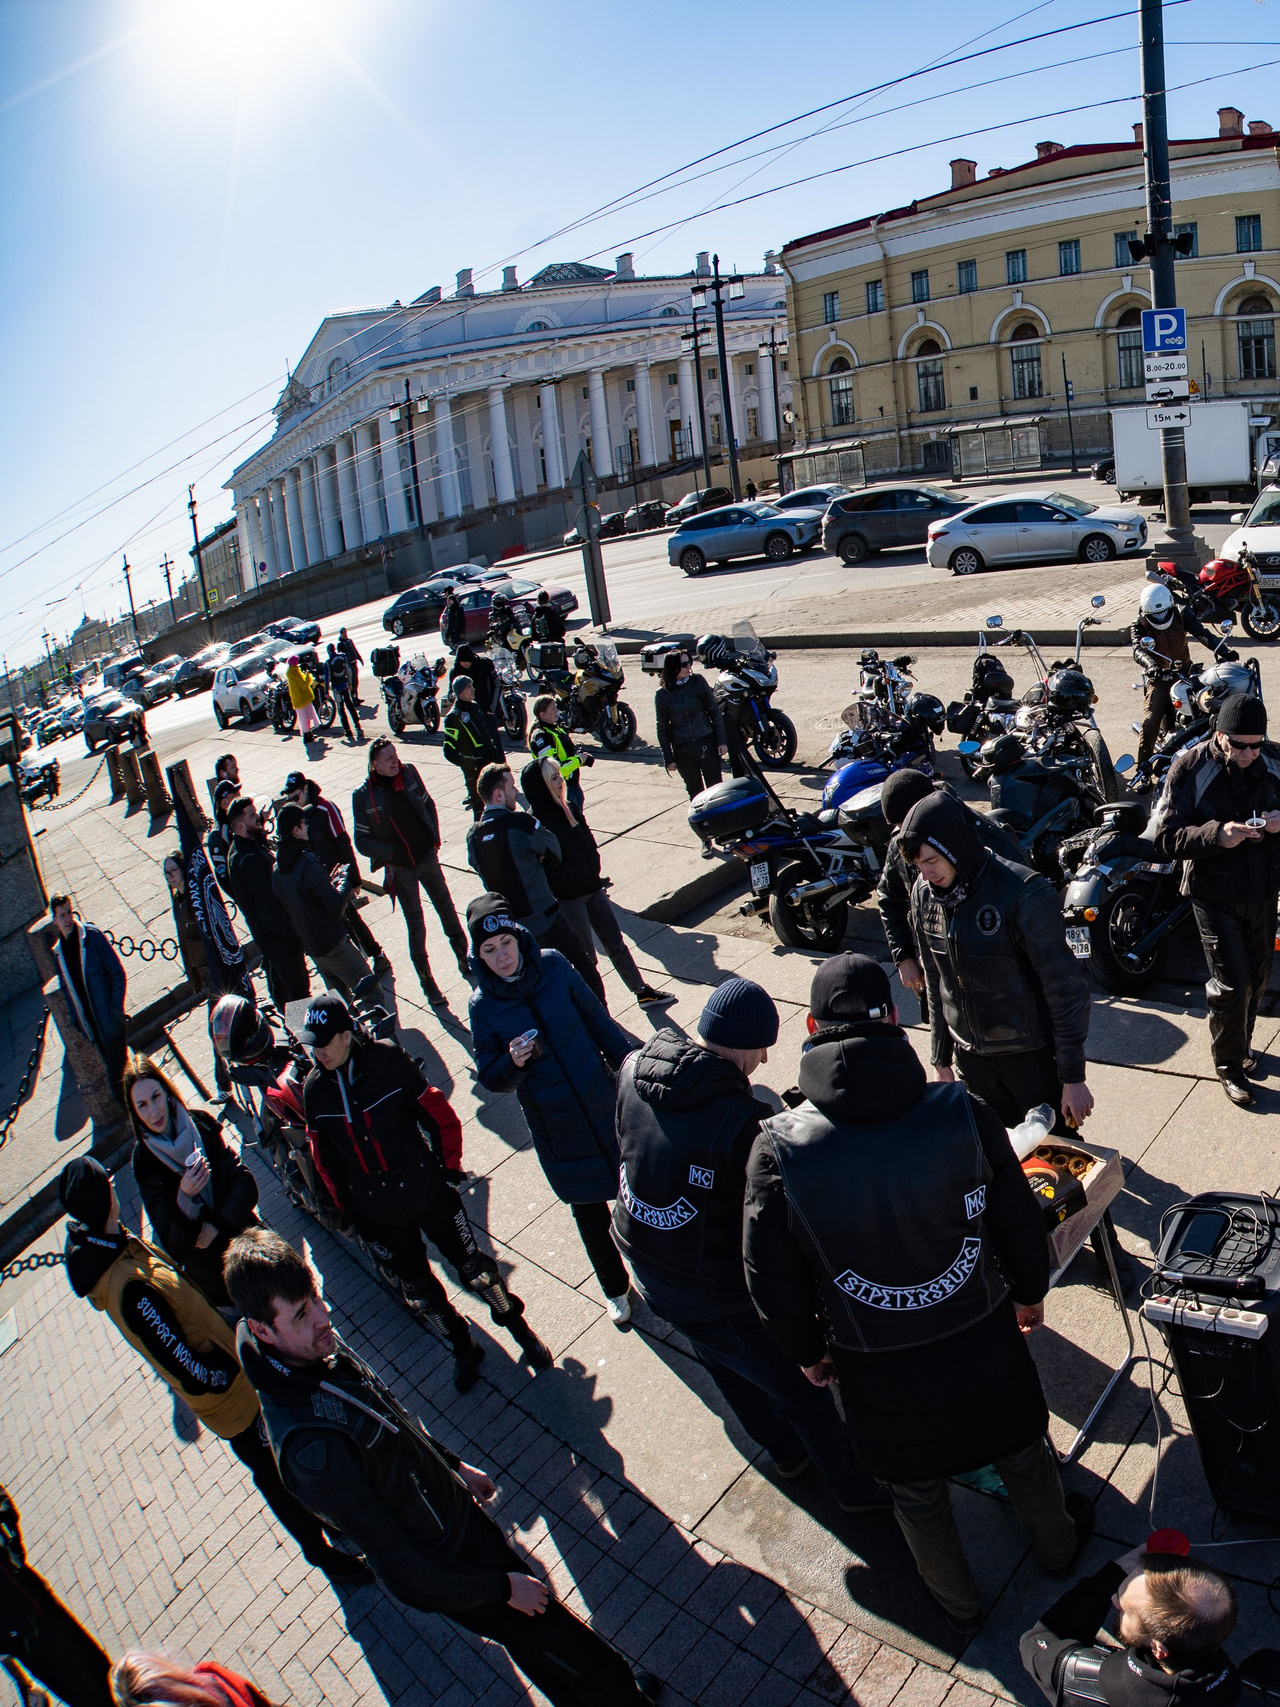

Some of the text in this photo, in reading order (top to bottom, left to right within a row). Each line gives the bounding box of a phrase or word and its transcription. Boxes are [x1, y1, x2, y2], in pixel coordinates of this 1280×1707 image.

[1154, 313, 1178, 347] P
[1146, 362, 1186, 373] 8.00-20.00
[1079, 943, 1090, 953] 78
[691, 1168, 711, 1186] MC
[843, 1246, 980, 1309] ST.PETERSBURG
[137, 1297, 177, 1348] SUPPORT
